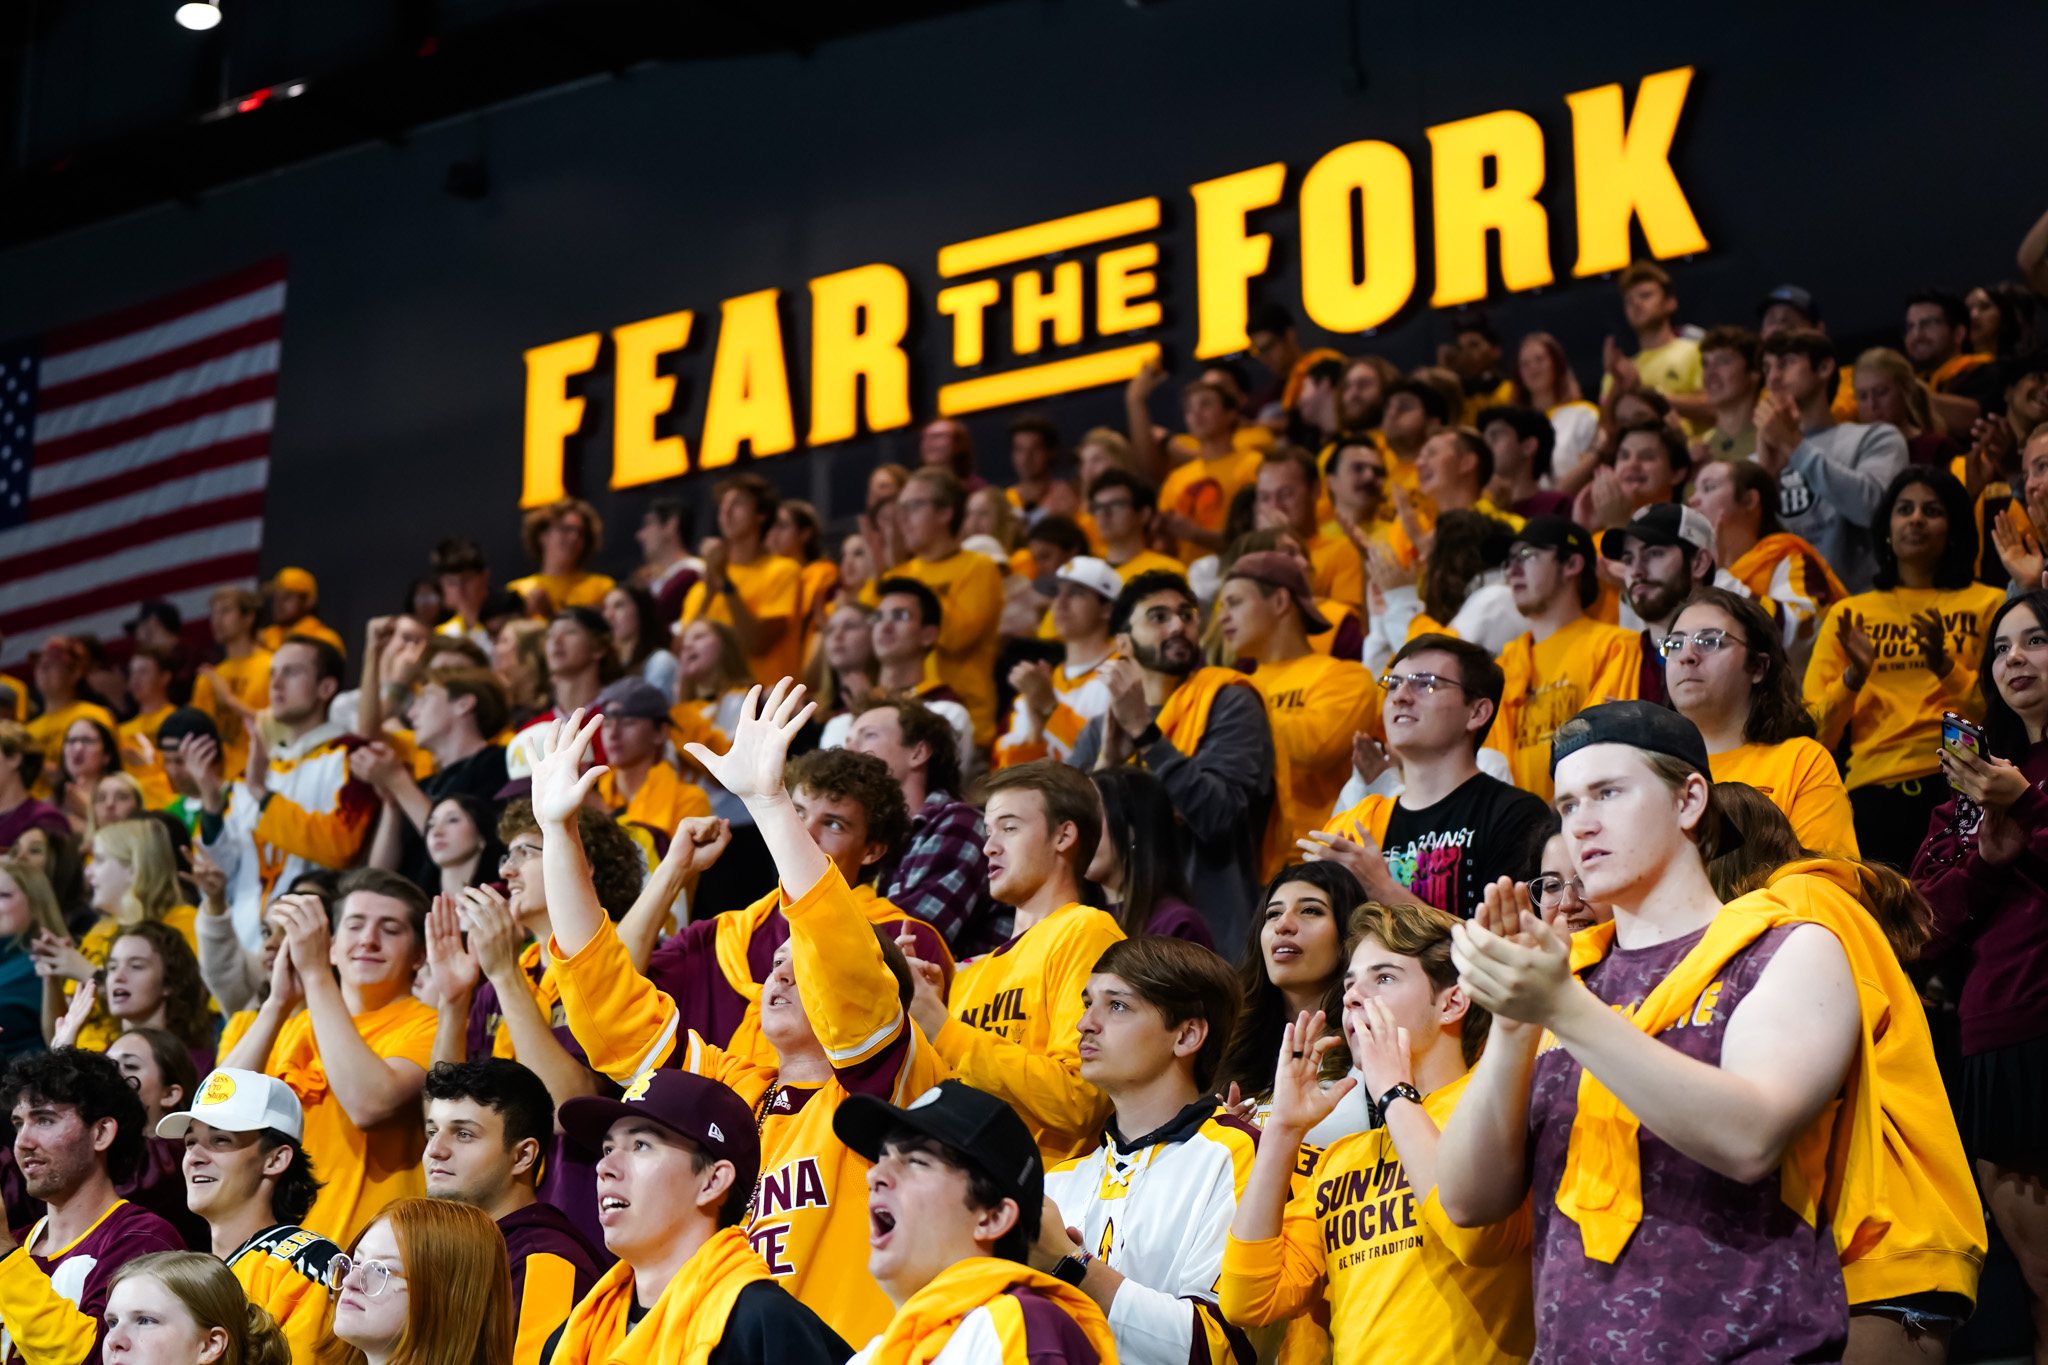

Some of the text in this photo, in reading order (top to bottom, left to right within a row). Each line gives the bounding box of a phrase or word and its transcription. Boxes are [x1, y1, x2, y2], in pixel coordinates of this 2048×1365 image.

[521, 67, 1709, 509] FEAR THE FORK
[1403, 827, 1476, 861] AGAINST
[1315, 1166, 1375, 1220] SUN
[1324, 1192, 1418, 1255] HOCKE
[1338, 1234, 1424, 1271] BE THE TRADITION
